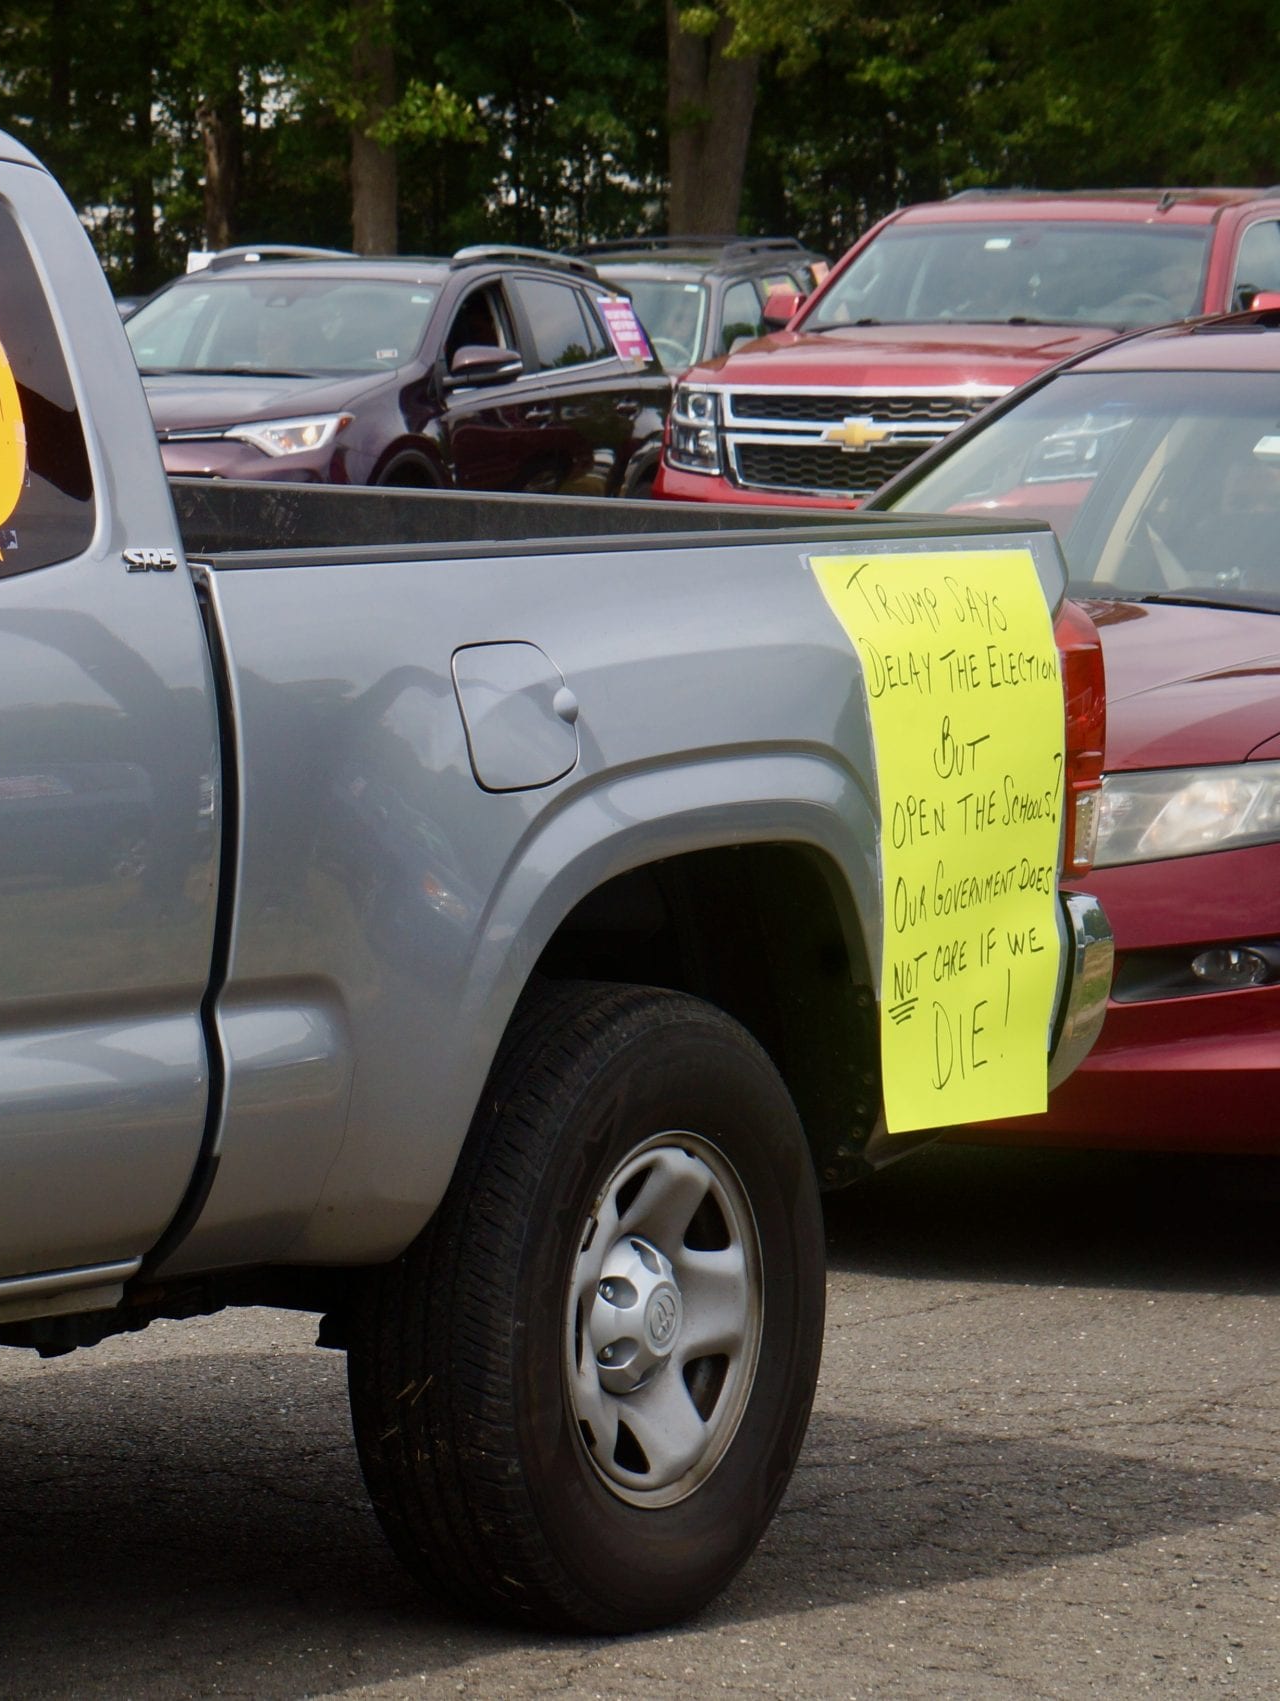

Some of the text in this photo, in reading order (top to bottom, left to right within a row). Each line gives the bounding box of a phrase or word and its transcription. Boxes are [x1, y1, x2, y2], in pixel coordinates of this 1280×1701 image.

[846, 563, 1007, 635] TRUMP SAYS
[859, 637, 1058, 698] DELAY THE ELECTION
[933, 715, 990, 779] BUT
[892, 795, 946, 849] OPEN
[957, 790, 996, 835] THE
[894, 857, 1053, 933] OUR GOVERNMENT DOES
[893, 926, 1044, 1001] NOT CARE IF WE
[931, 967, 1012, 1090] DIE!
